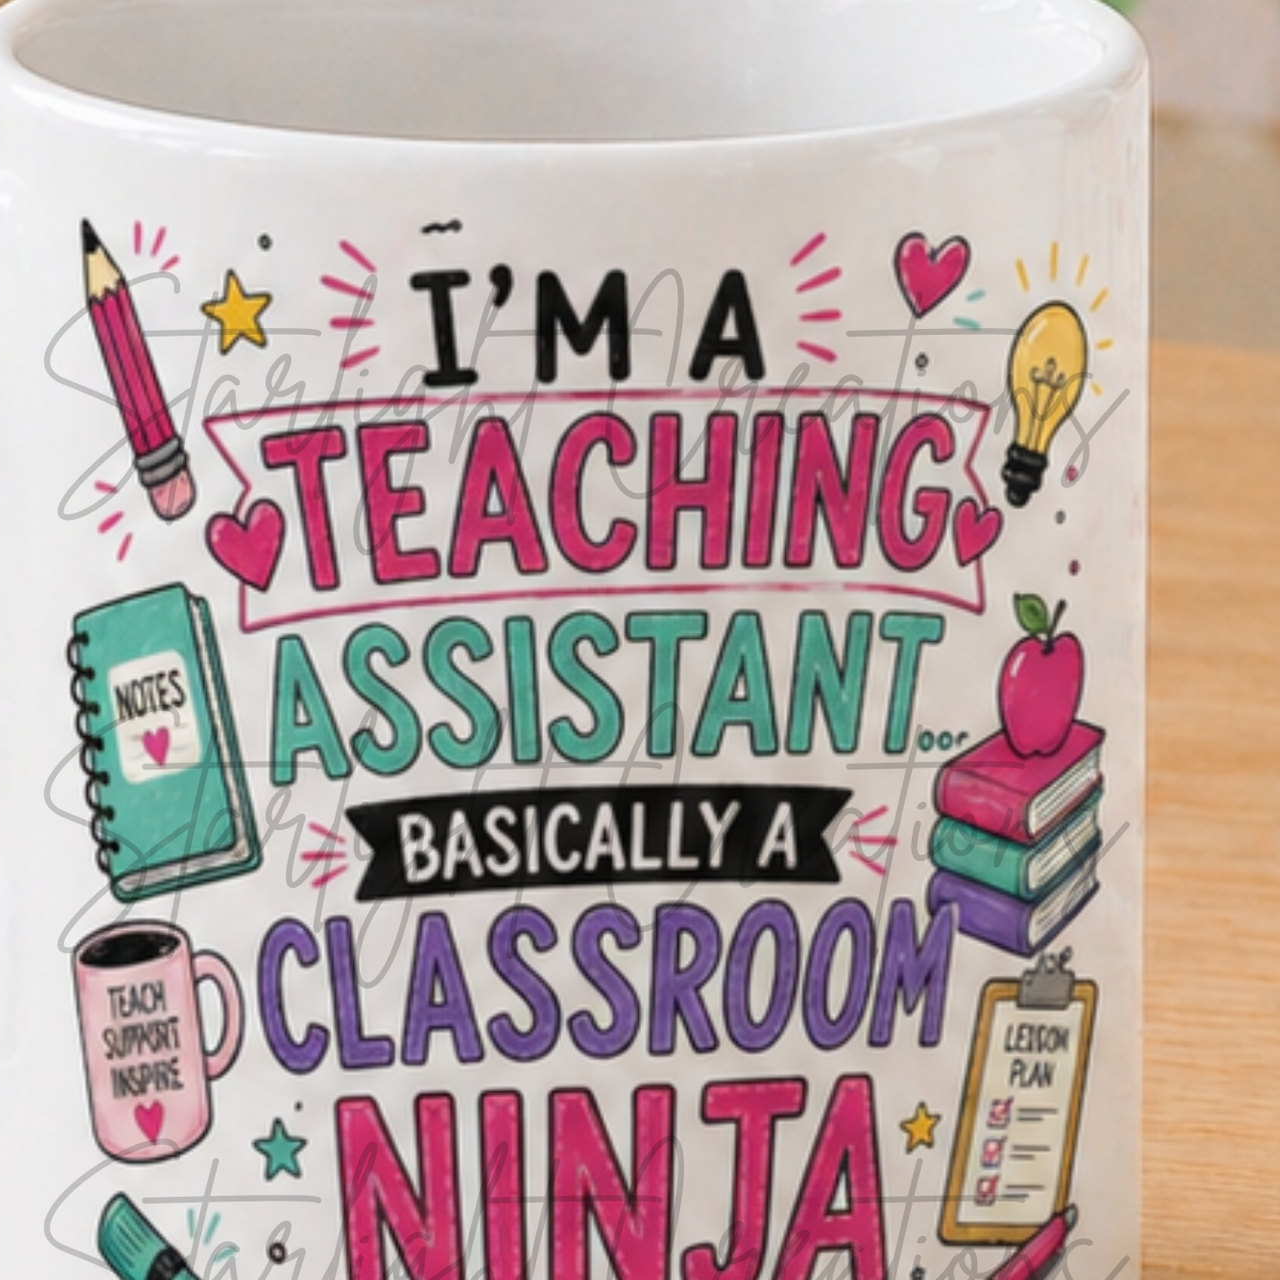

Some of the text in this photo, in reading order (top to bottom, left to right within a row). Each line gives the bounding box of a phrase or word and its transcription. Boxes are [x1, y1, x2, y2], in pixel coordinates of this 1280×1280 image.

[687, 267, 767, 381] A
[260, 410, 959, 592] TEACHING
[114, 668, 188, 721] NOTES
[397, 799, 799, 883] BASICALLY A
[106, 980, 167, 1020] TEACH
[256, 896, 961, 1075] CLASSROOM
[1008, 1057, 1057, 1089] PLAN
